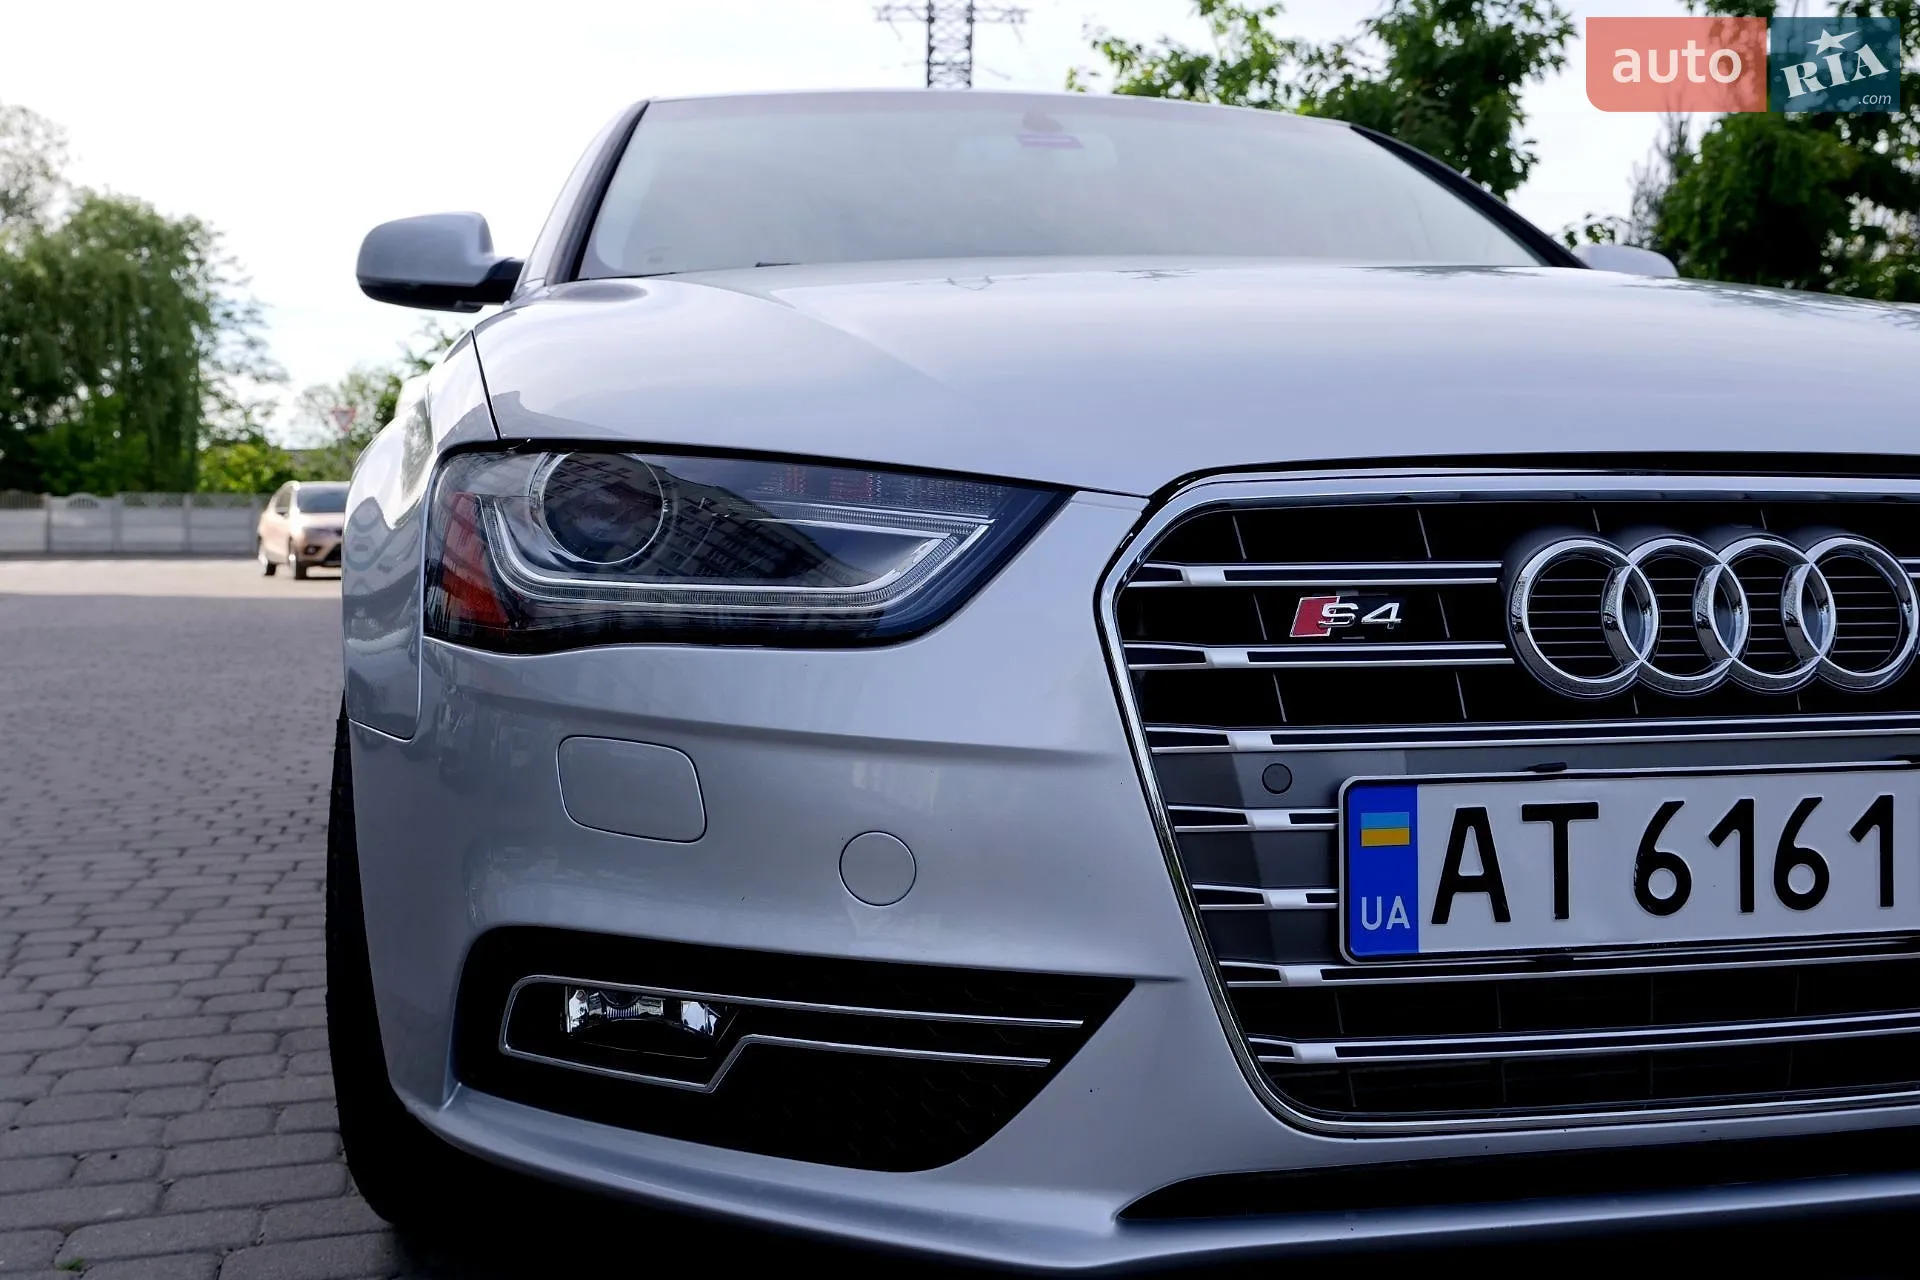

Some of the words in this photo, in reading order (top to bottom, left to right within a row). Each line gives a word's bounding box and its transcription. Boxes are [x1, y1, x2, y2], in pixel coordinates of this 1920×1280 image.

[1318, 602, 1402, 629] S4
[1430, 801, 1599, 925] AT
[1632, 794, 1895, 917] 6161
[1361, 895, 1411, 931] UA
